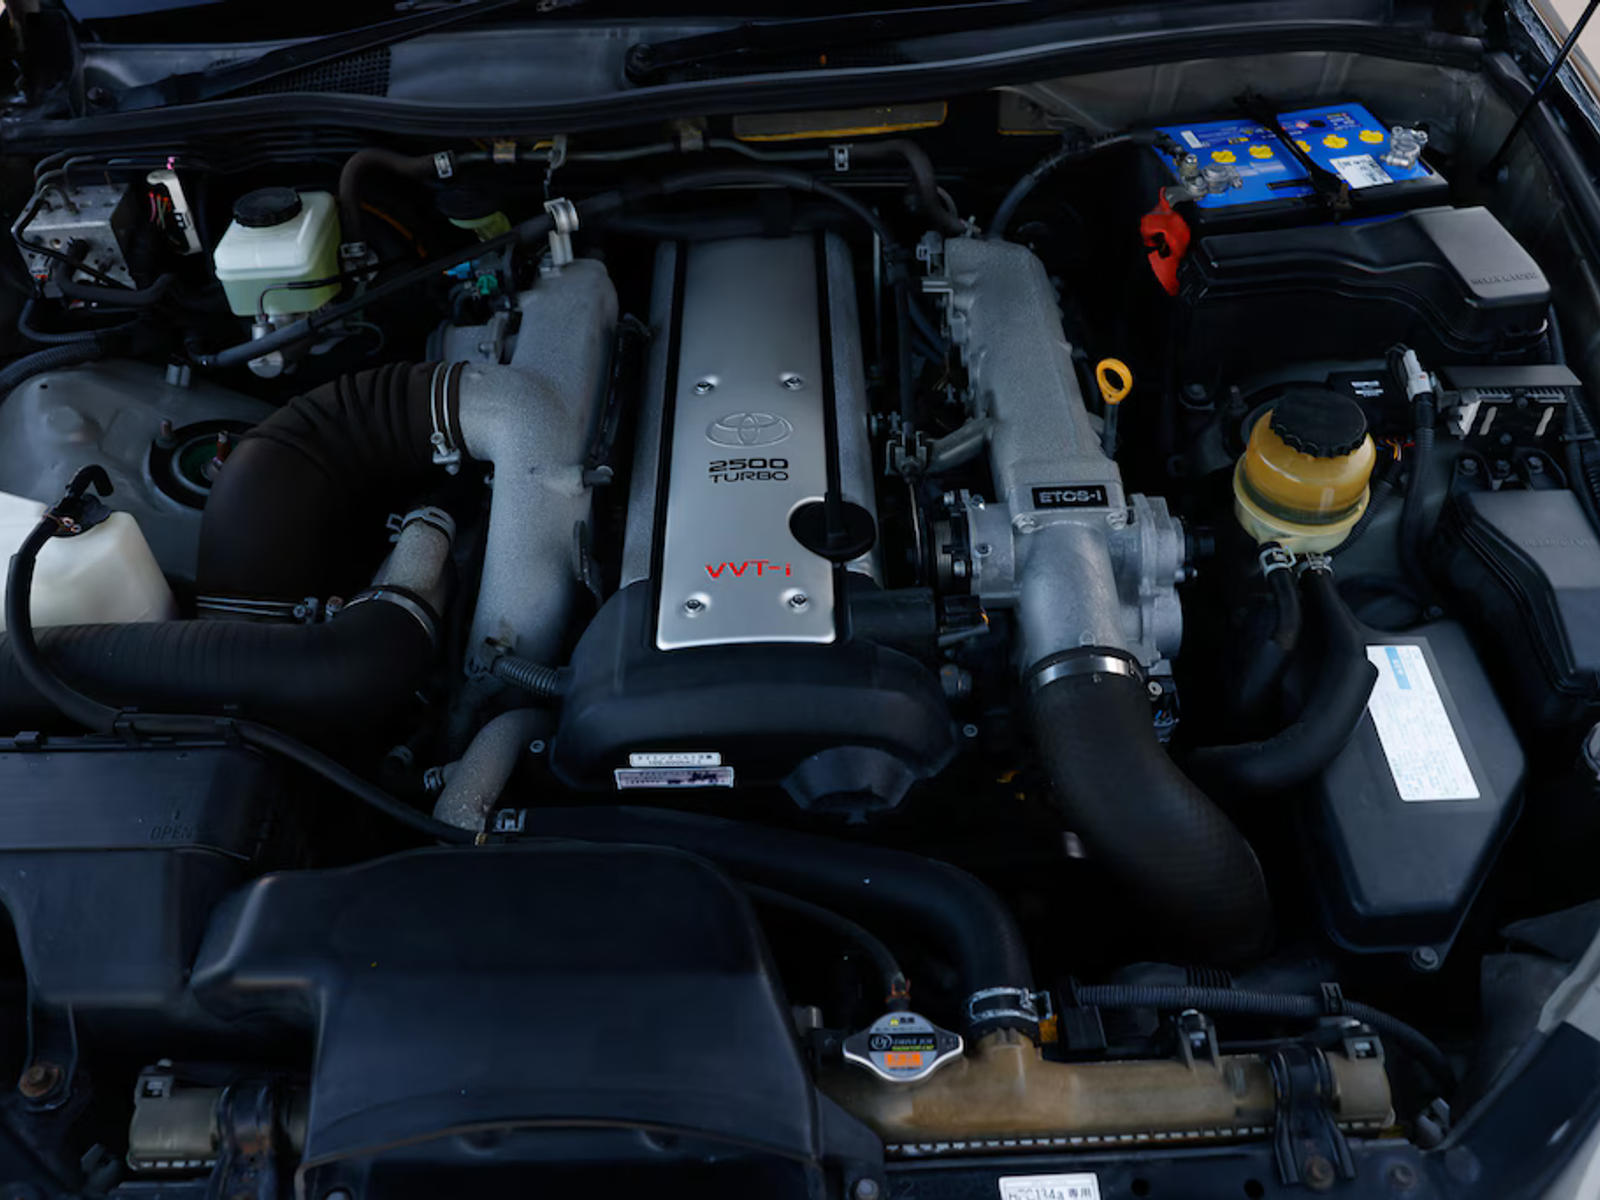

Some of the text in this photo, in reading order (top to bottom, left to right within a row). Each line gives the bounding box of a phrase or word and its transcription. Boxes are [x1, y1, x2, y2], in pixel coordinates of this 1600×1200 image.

[709, 458, 788, 472] 2500
[709, 471, 789, 483] TURBO
[704, 559, 790, 578] VVT-i
